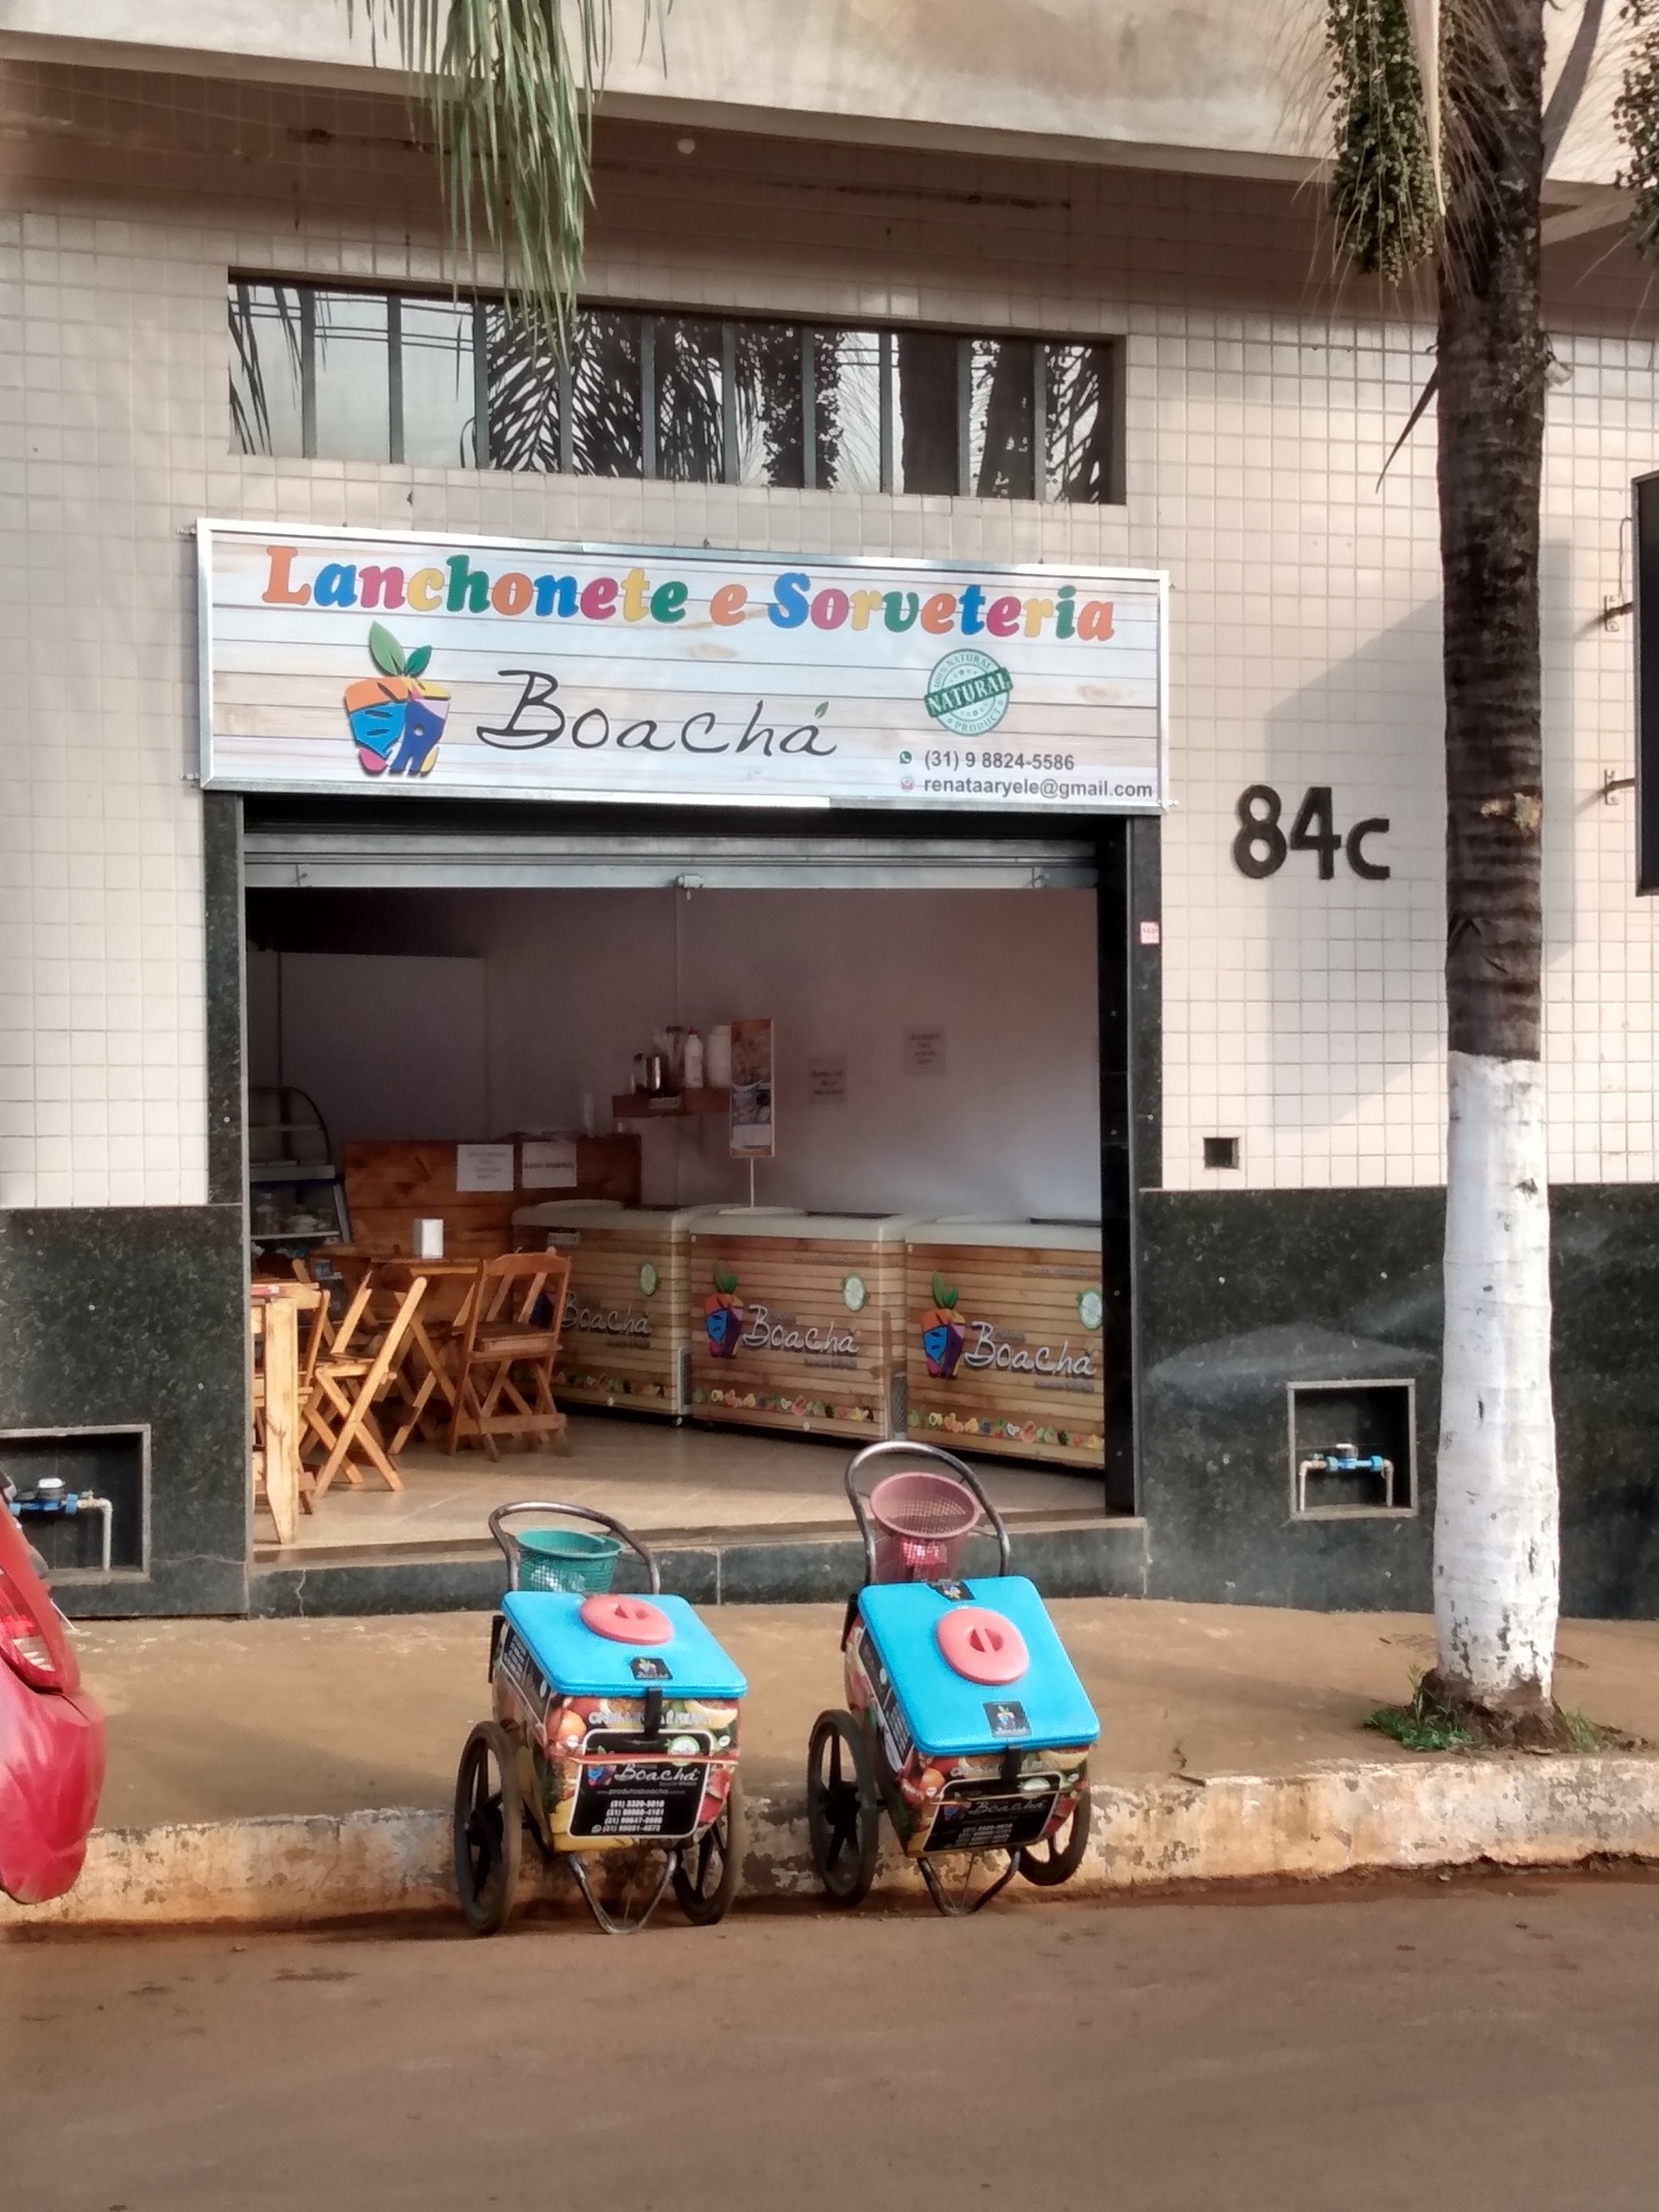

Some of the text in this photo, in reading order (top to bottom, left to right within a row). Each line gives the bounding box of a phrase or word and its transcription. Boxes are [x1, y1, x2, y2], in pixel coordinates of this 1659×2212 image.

[262, 545, 1115, 642] Lanchonete e Sorveteria
[927, 671, 1010, 716] NATURAL
[924, 750, 1075, 771] (31) 9 8824-5586
[924, 776, 1154, 799] renataaryele@gmail.com
